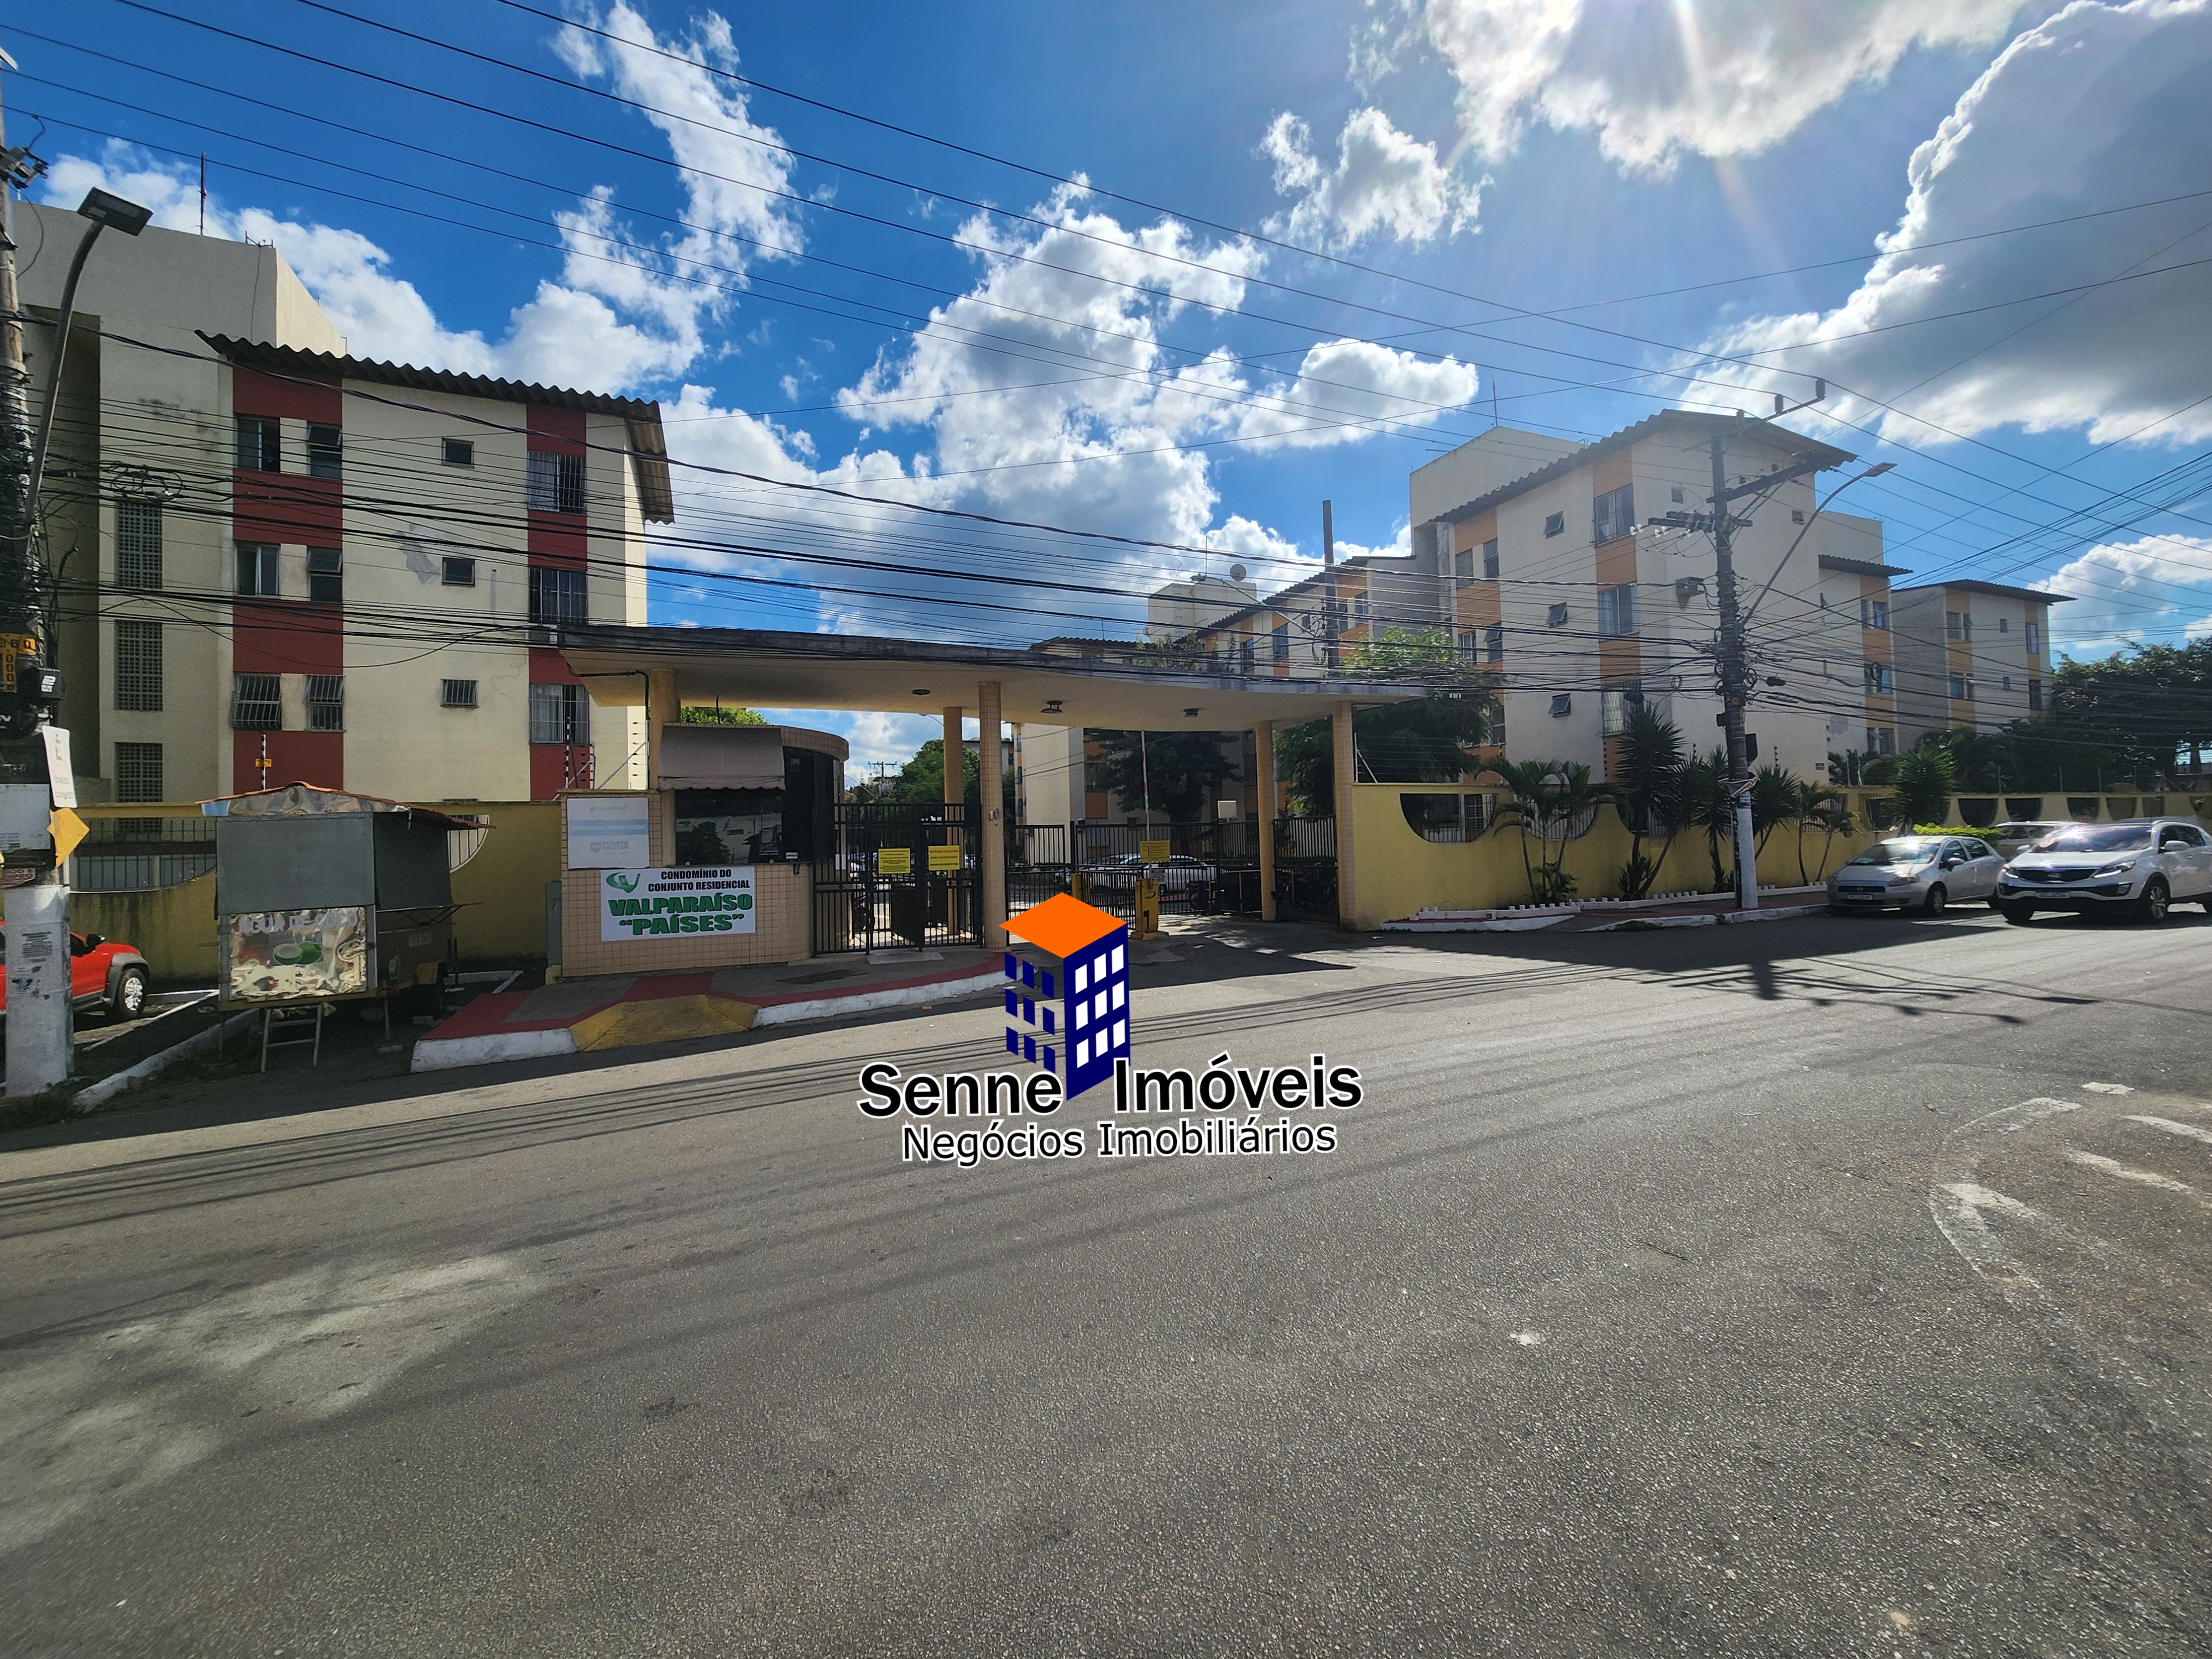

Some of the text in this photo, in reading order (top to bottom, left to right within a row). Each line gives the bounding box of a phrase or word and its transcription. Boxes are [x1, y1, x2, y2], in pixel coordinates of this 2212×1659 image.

[988, 808, 1001, 820] 10
[661, 869, 732, 880] CONDOMÍNIO DO
[648, 880, 750, 892] CONJUNTO RESIDENCIAL
[608, 893, 753, 916] VALPARAÍSO
